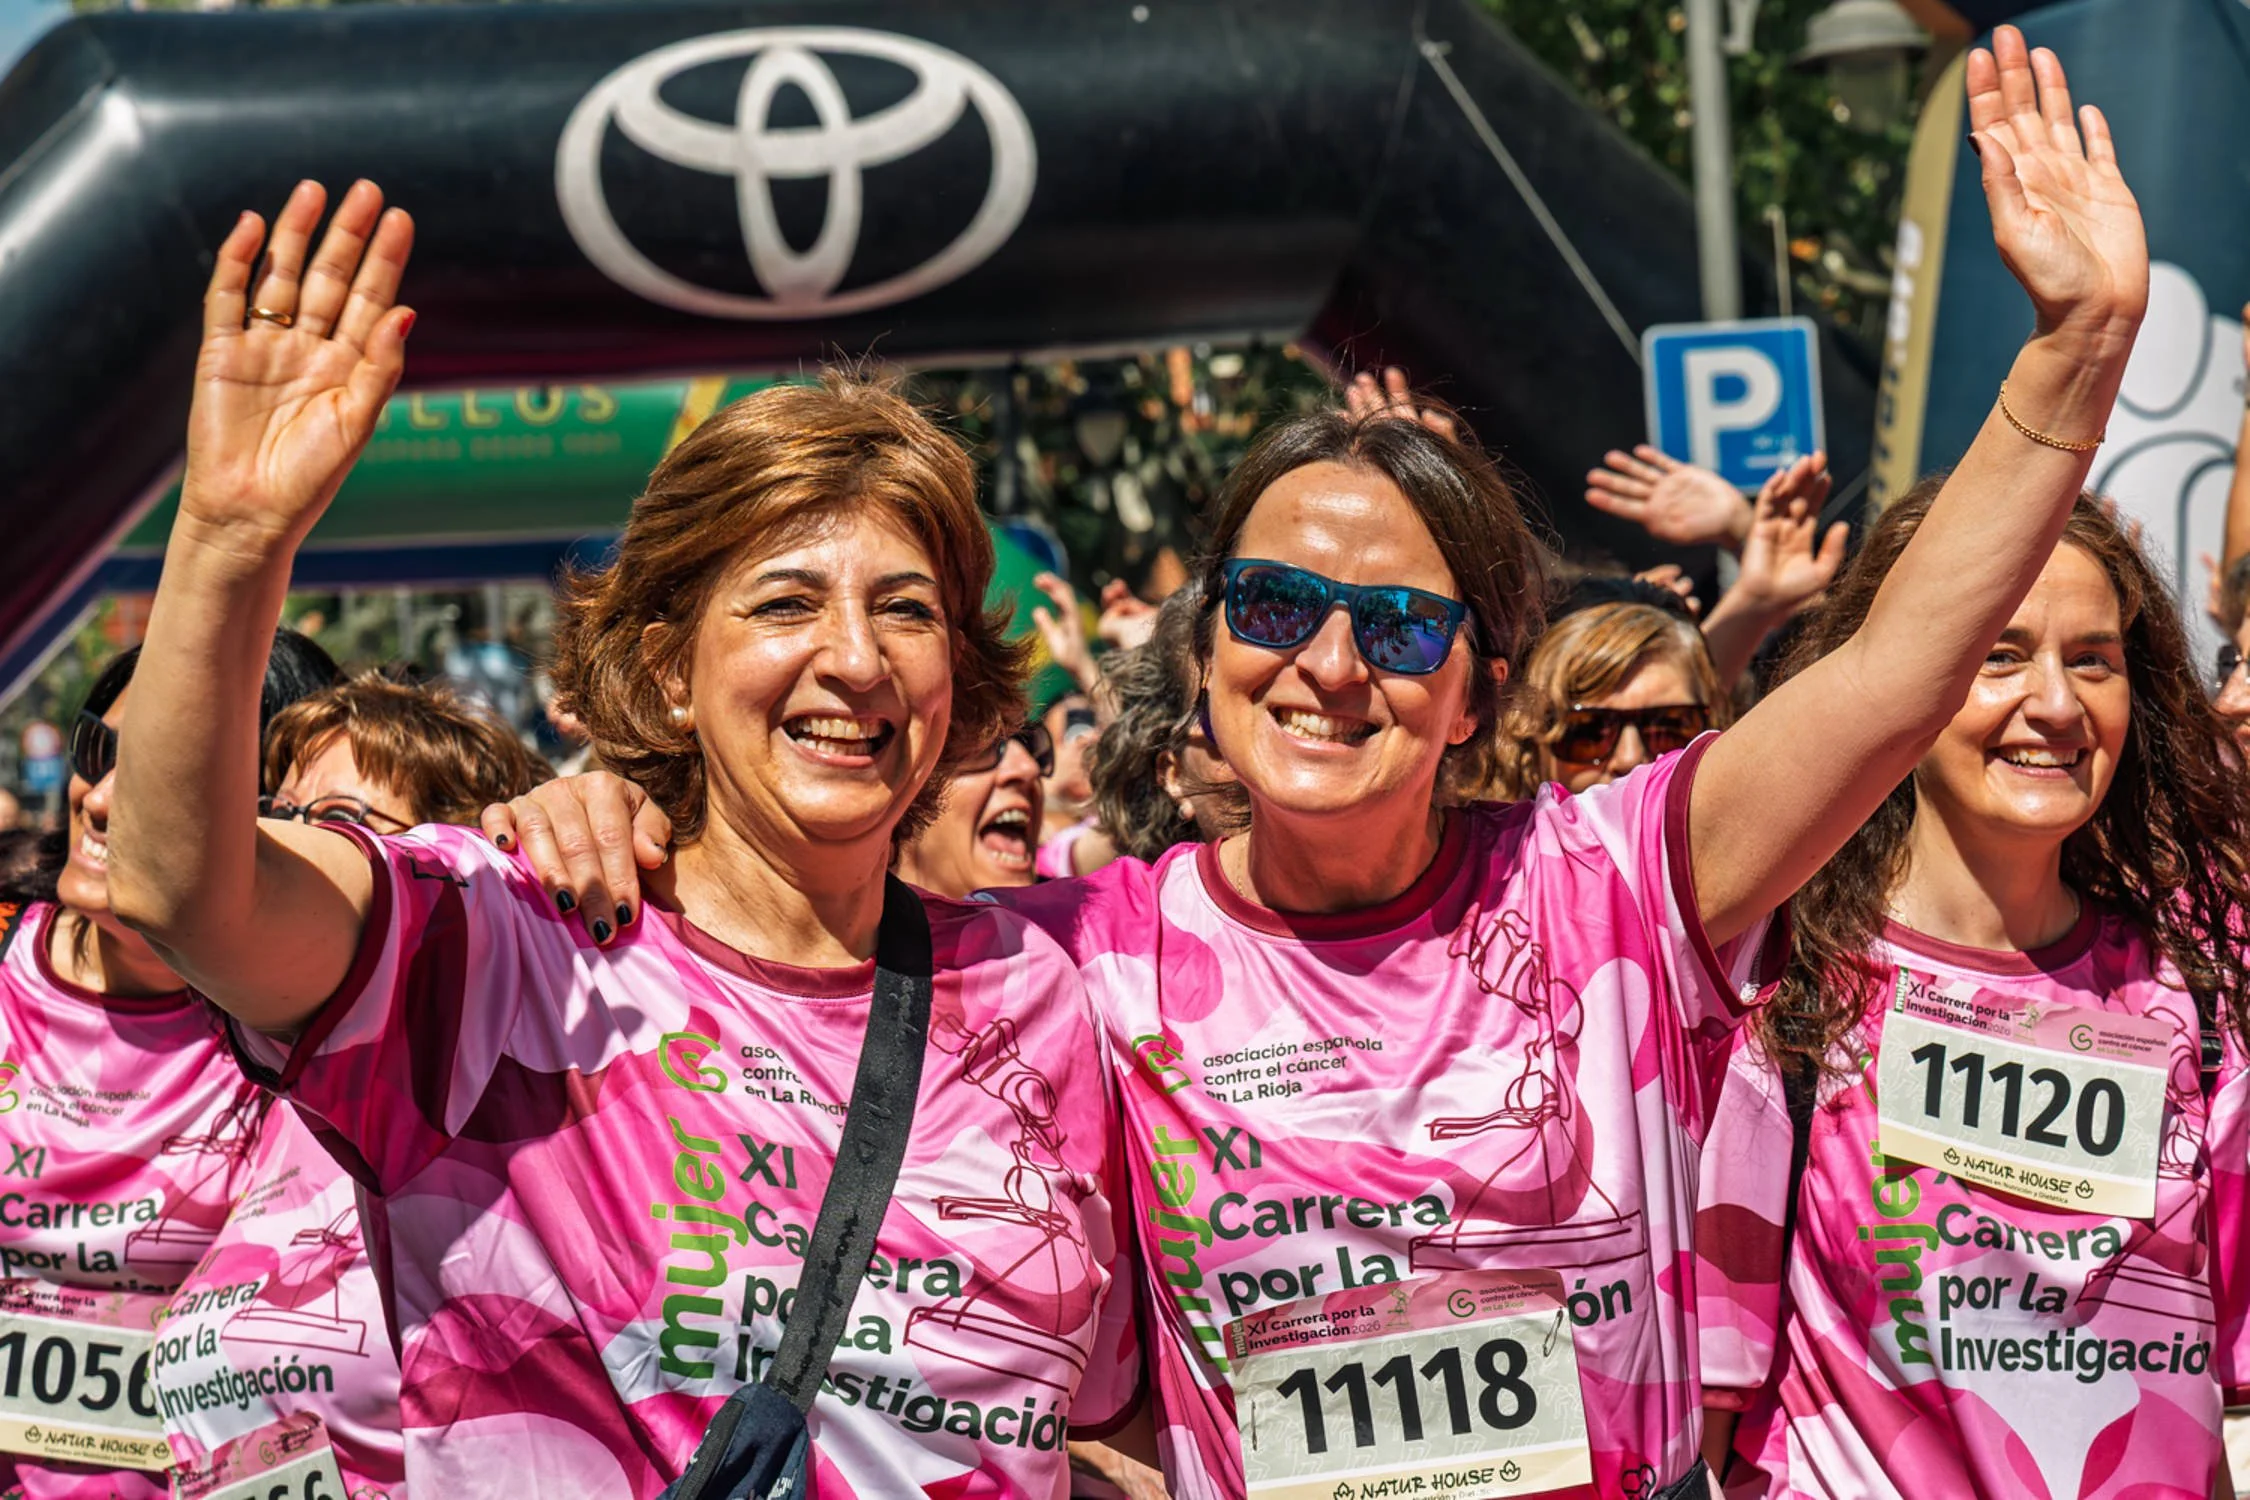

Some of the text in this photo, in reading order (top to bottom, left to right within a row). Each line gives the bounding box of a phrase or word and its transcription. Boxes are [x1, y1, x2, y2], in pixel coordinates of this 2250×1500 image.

[373, 384, 616, 430] LLOS
[1684, 346, 1782, 473] P
[1906, 999, 1988, 1030] Investigación
[1908, 981, 2010, 1021] XI Carrera por la
[1203, 1036, 1383, 1068] asociación española
[1203, 1056, 1348, 1086] contra el cáncer
[745, 1085, 794, 1103] en La
[1232, 1089, 1254, 1103] La
[1258, 1080, 1303, 1100] Rioja
[1911, 1041, 2126, 1157] 11120
[3, 1142, 46, 1180] XI
[737, 1133, 798, 1189] XI
[1201, 1126, 1262, 1175] XI
[1963, 1155, 2072, 1194] NATUR HOUSE
[0, 1193, 159, 1230] Carrera
[1208, 1192, 1451, 1241] Carrera
[1936, 1203, 2122, 1262] Carrera
[1, 1242, 118, 1278] por la
[651, 1116, 749, 1380] mujer
[744, 1201, 962, 1298] Caera
[1218, 1246, 1402, 1318] por la
[1938, 1272, 2069, 1321] por la
[1247, 1305, 1375, 1336] XI Carrera por la
[1249, 1320, 1381, 1350] Investigación 2026
[154, 1323, 216, 1378] por la
[1941, 1327, 2211, 1384] Investigació
[158, 1355, 334, 1419] Investigación
[1276, 1338, 1537, 1455] 11118
[1360, 1477, 1427, 1500] NATUR
[1431, 1468, 1494, 1490] HOUSE
